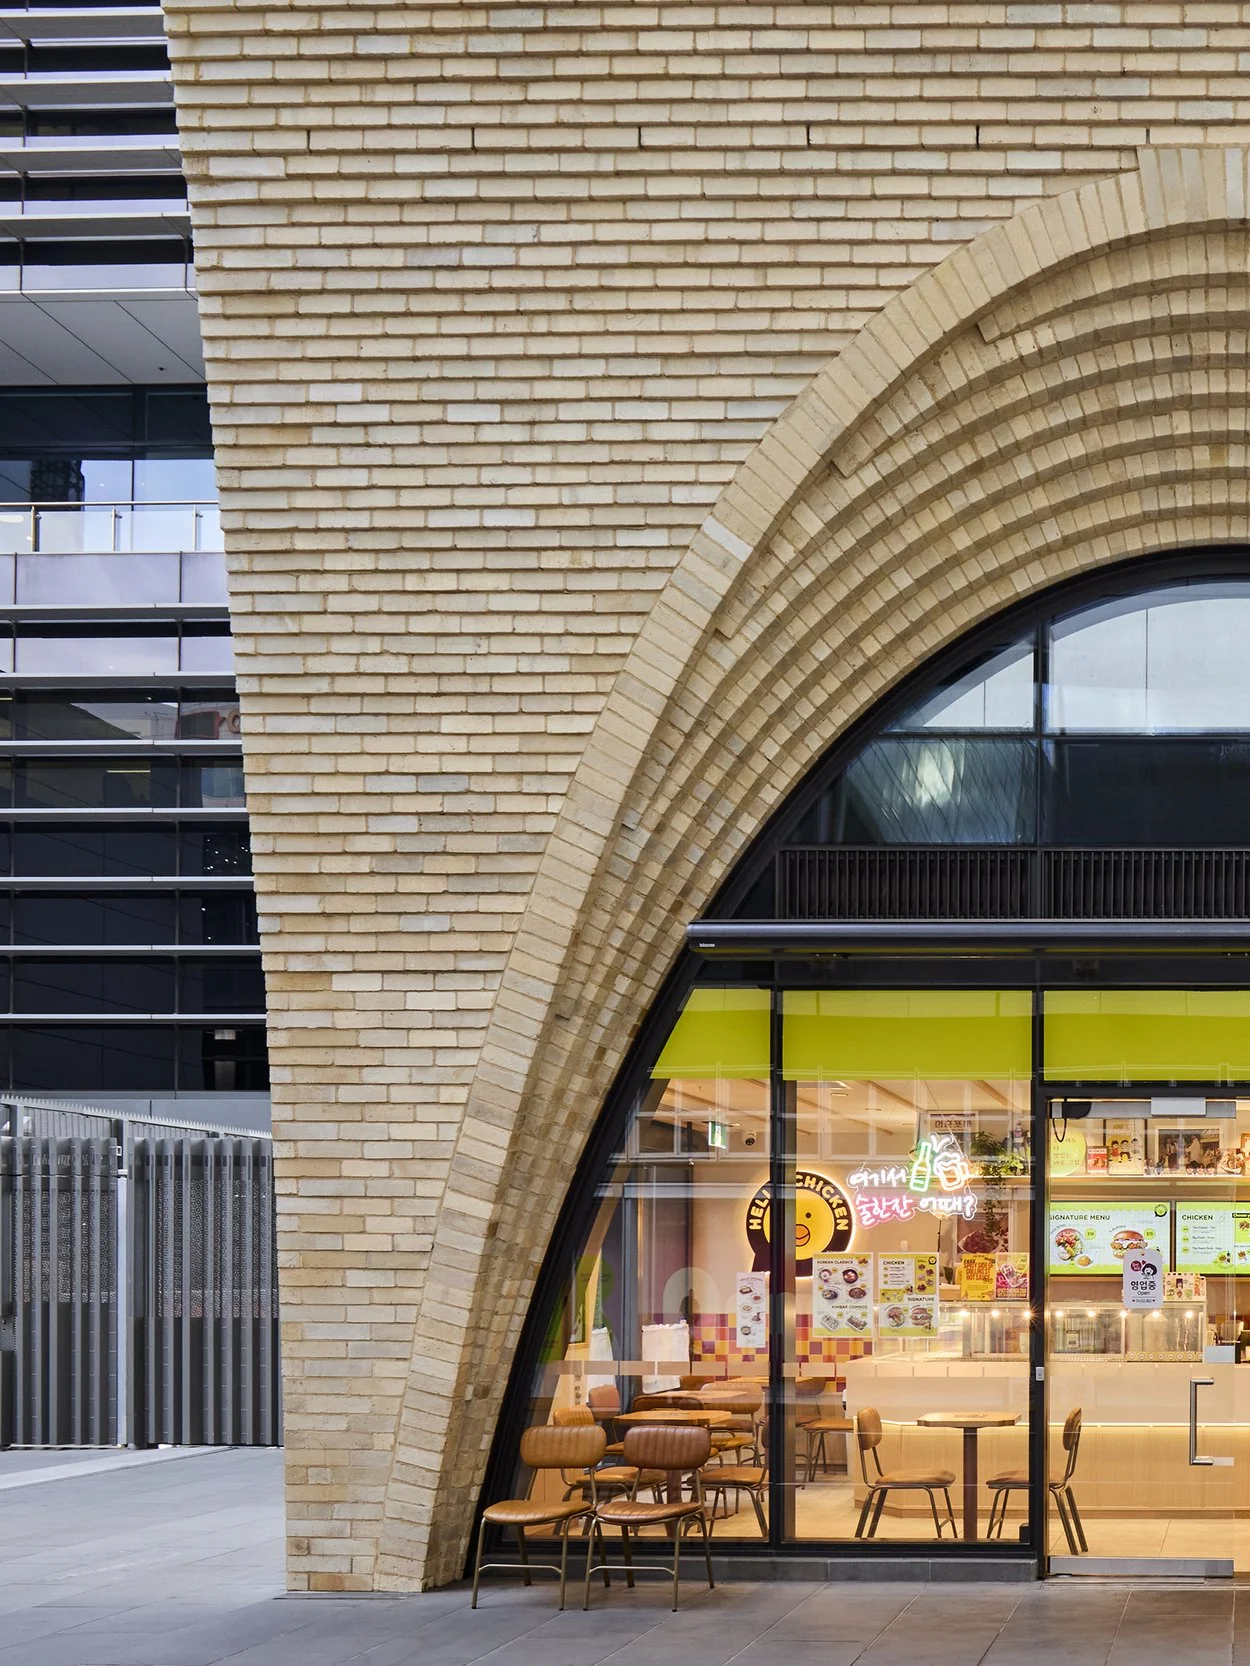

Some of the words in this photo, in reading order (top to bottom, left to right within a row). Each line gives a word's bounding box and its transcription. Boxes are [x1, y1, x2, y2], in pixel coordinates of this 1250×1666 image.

[849, 1166, 907, 1187] 여기서
[748, 1189, 770, 1230] HELL
[796, 1174, 849, 1231] CHICKEN
[919, 1195, 975, 1217] 어때?
[1130, 1280, 1157, 1291] 영업중
